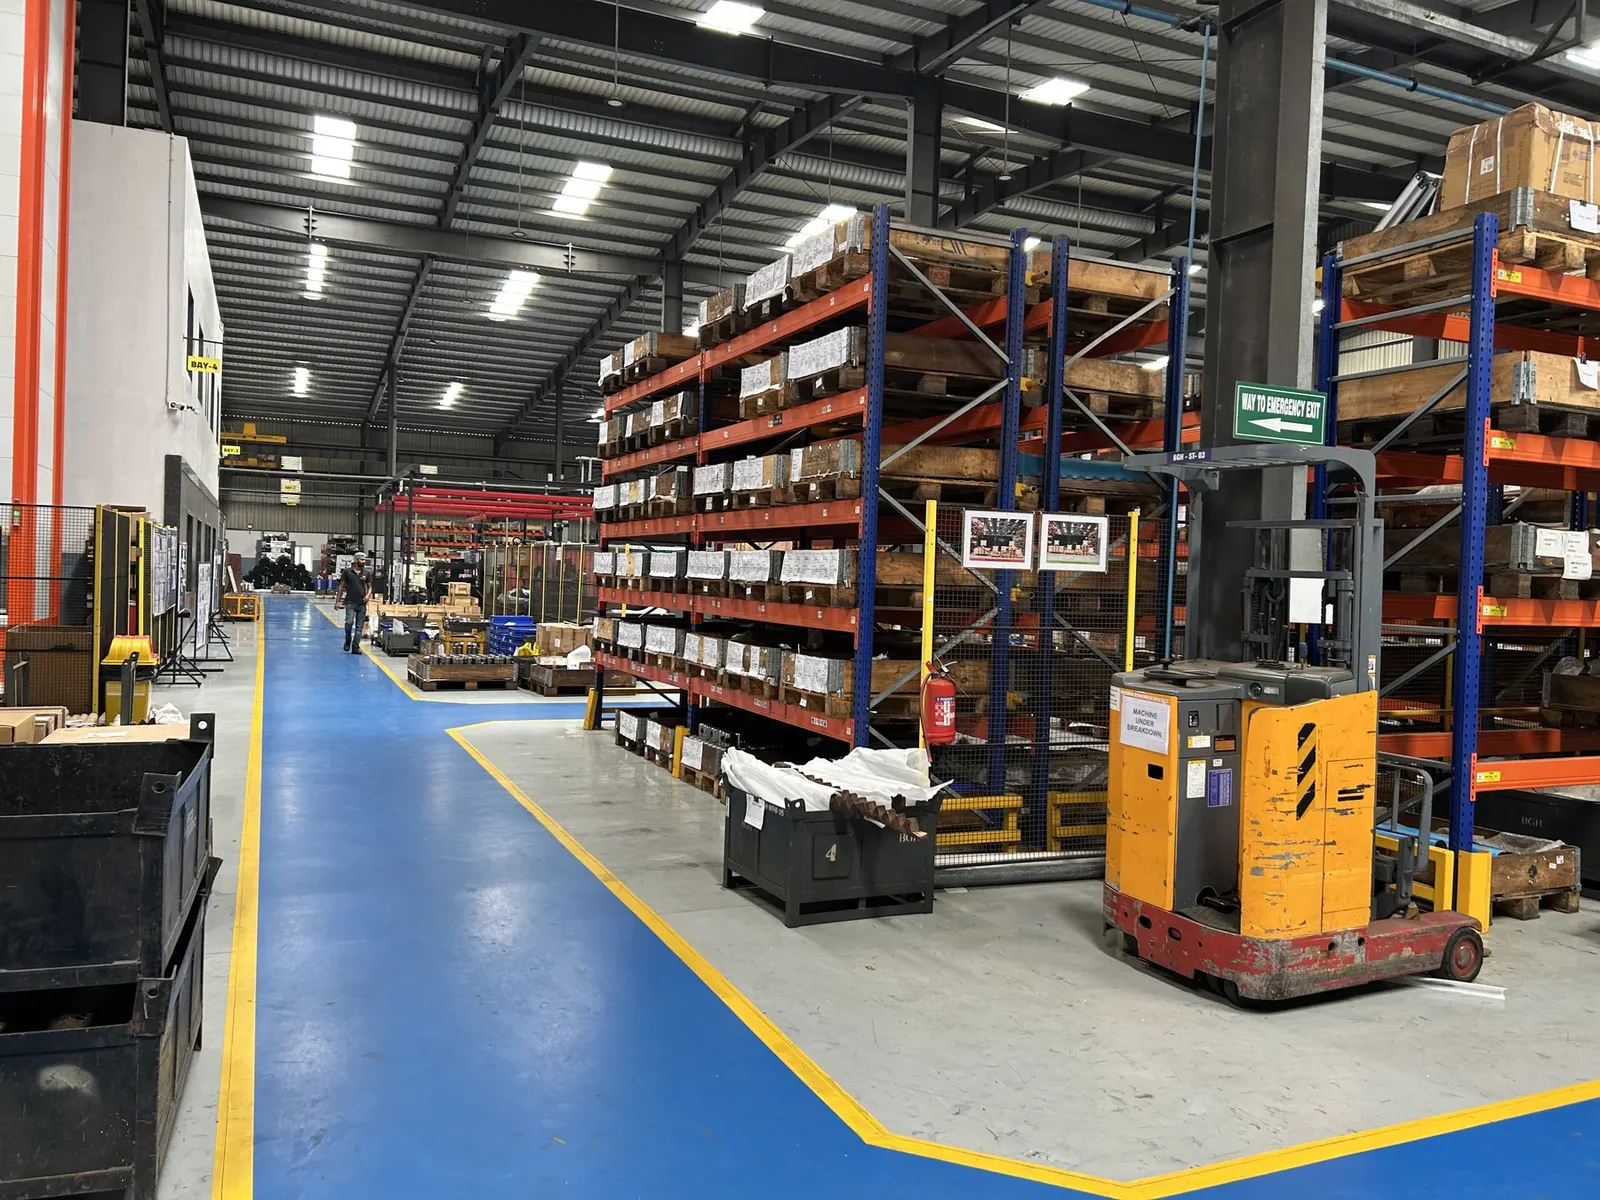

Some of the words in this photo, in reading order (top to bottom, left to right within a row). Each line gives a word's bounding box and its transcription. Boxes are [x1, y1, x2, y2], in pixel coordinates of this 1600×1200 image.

[191, 361, 218, 370] BAY-4
[1242, 392, 1256, 411] WAY
[1257, 394, 1266, 412] TO
[1266, 396, 1306, 417] EMERGENCY
[1306, 401, 1321, 419] EXIT
[1173, 453, 1184, 461] BGH
[1132, 708, 1157, 719] MACHINE
[1135, 717, 1154, 727] UNDER
[1126, 723, 1162, 737] BREAKDOWN
[1521, 816, 1543, 828] BGH
[825, 844, 837, 861] 4
